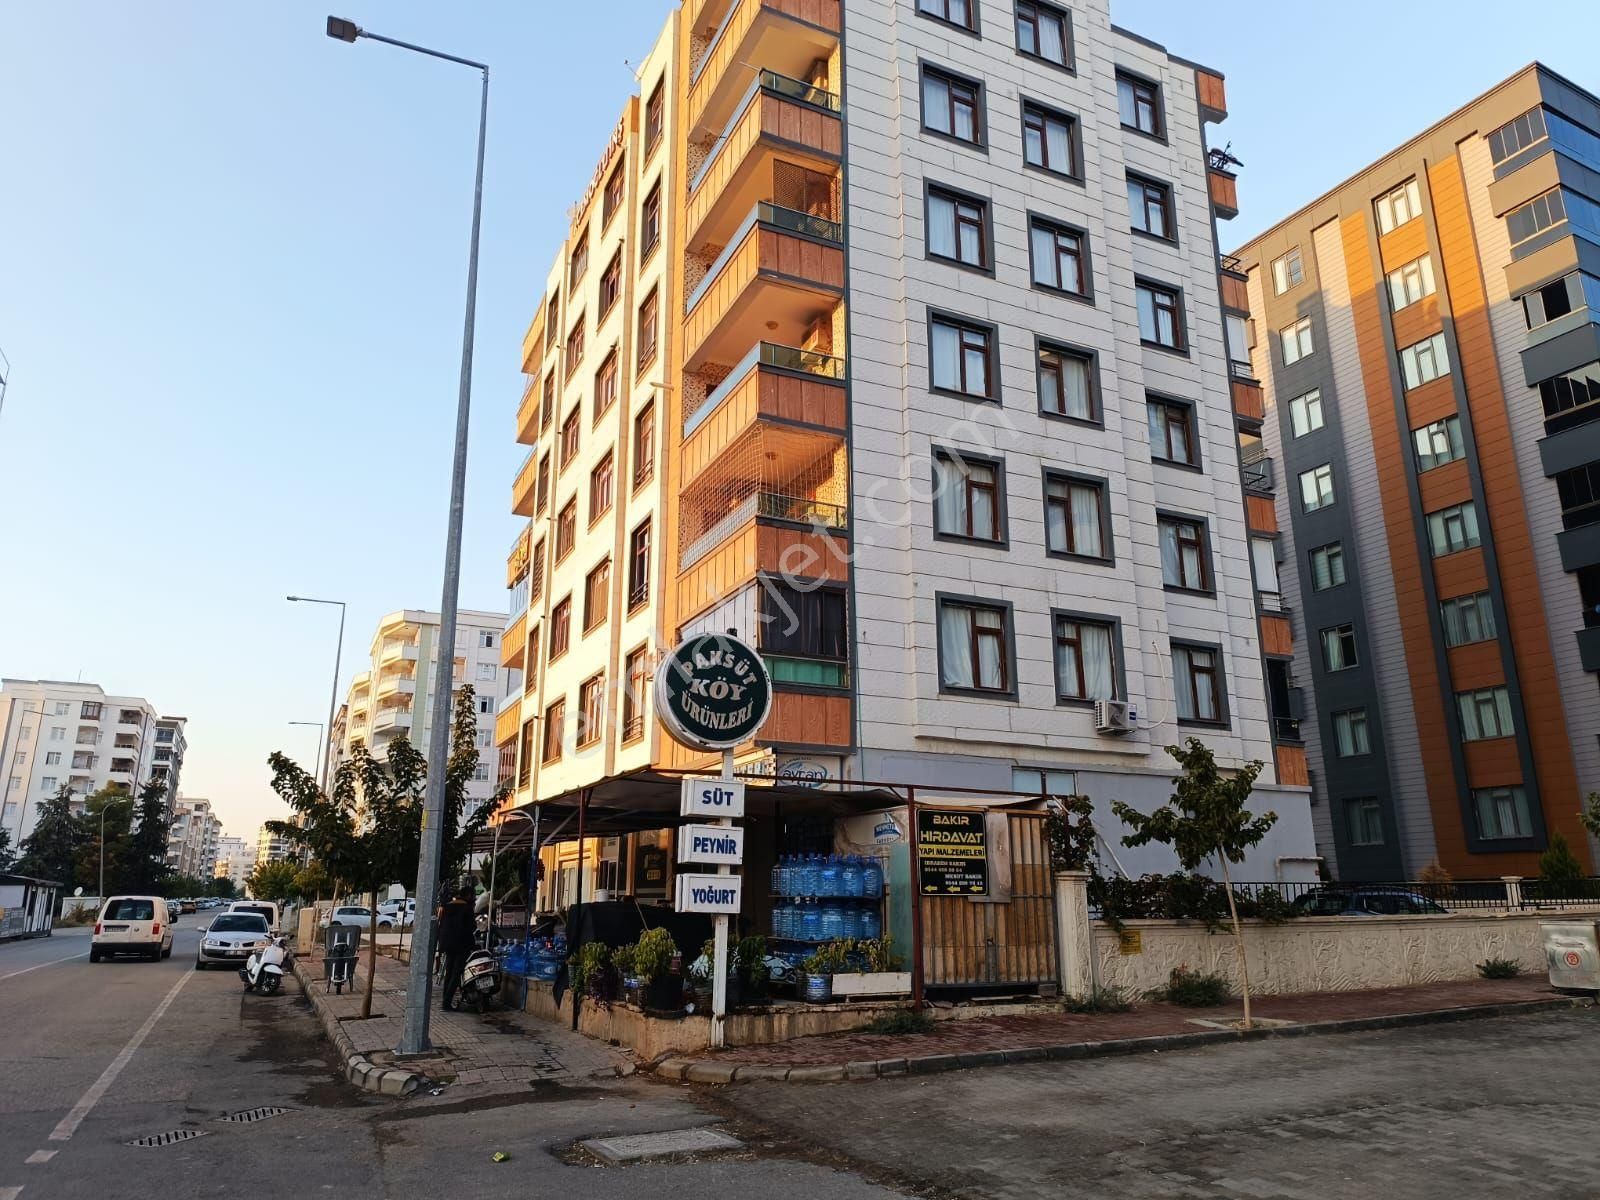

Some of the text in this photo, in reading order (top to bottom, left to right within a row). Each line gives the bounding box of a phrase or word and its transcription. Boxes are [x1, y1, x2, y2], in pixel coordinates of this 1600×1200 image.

[681, 650, 757, 684] PAKSÜT
[689, 676, 747, 700] KÖY
[681, 690, 754, 730] ÜRÜNLERİ
[702, 788, 734, 806] SÜT
[933, 815, 969, 825] BAKIR
[693, 835, 737, 855] PEYNİR
[920, 831, 983, 843] HIRDAVAT
[936, 848, 984, 856] MALZEMELERİ
[692, 886, 736, 905] YOĞURT
